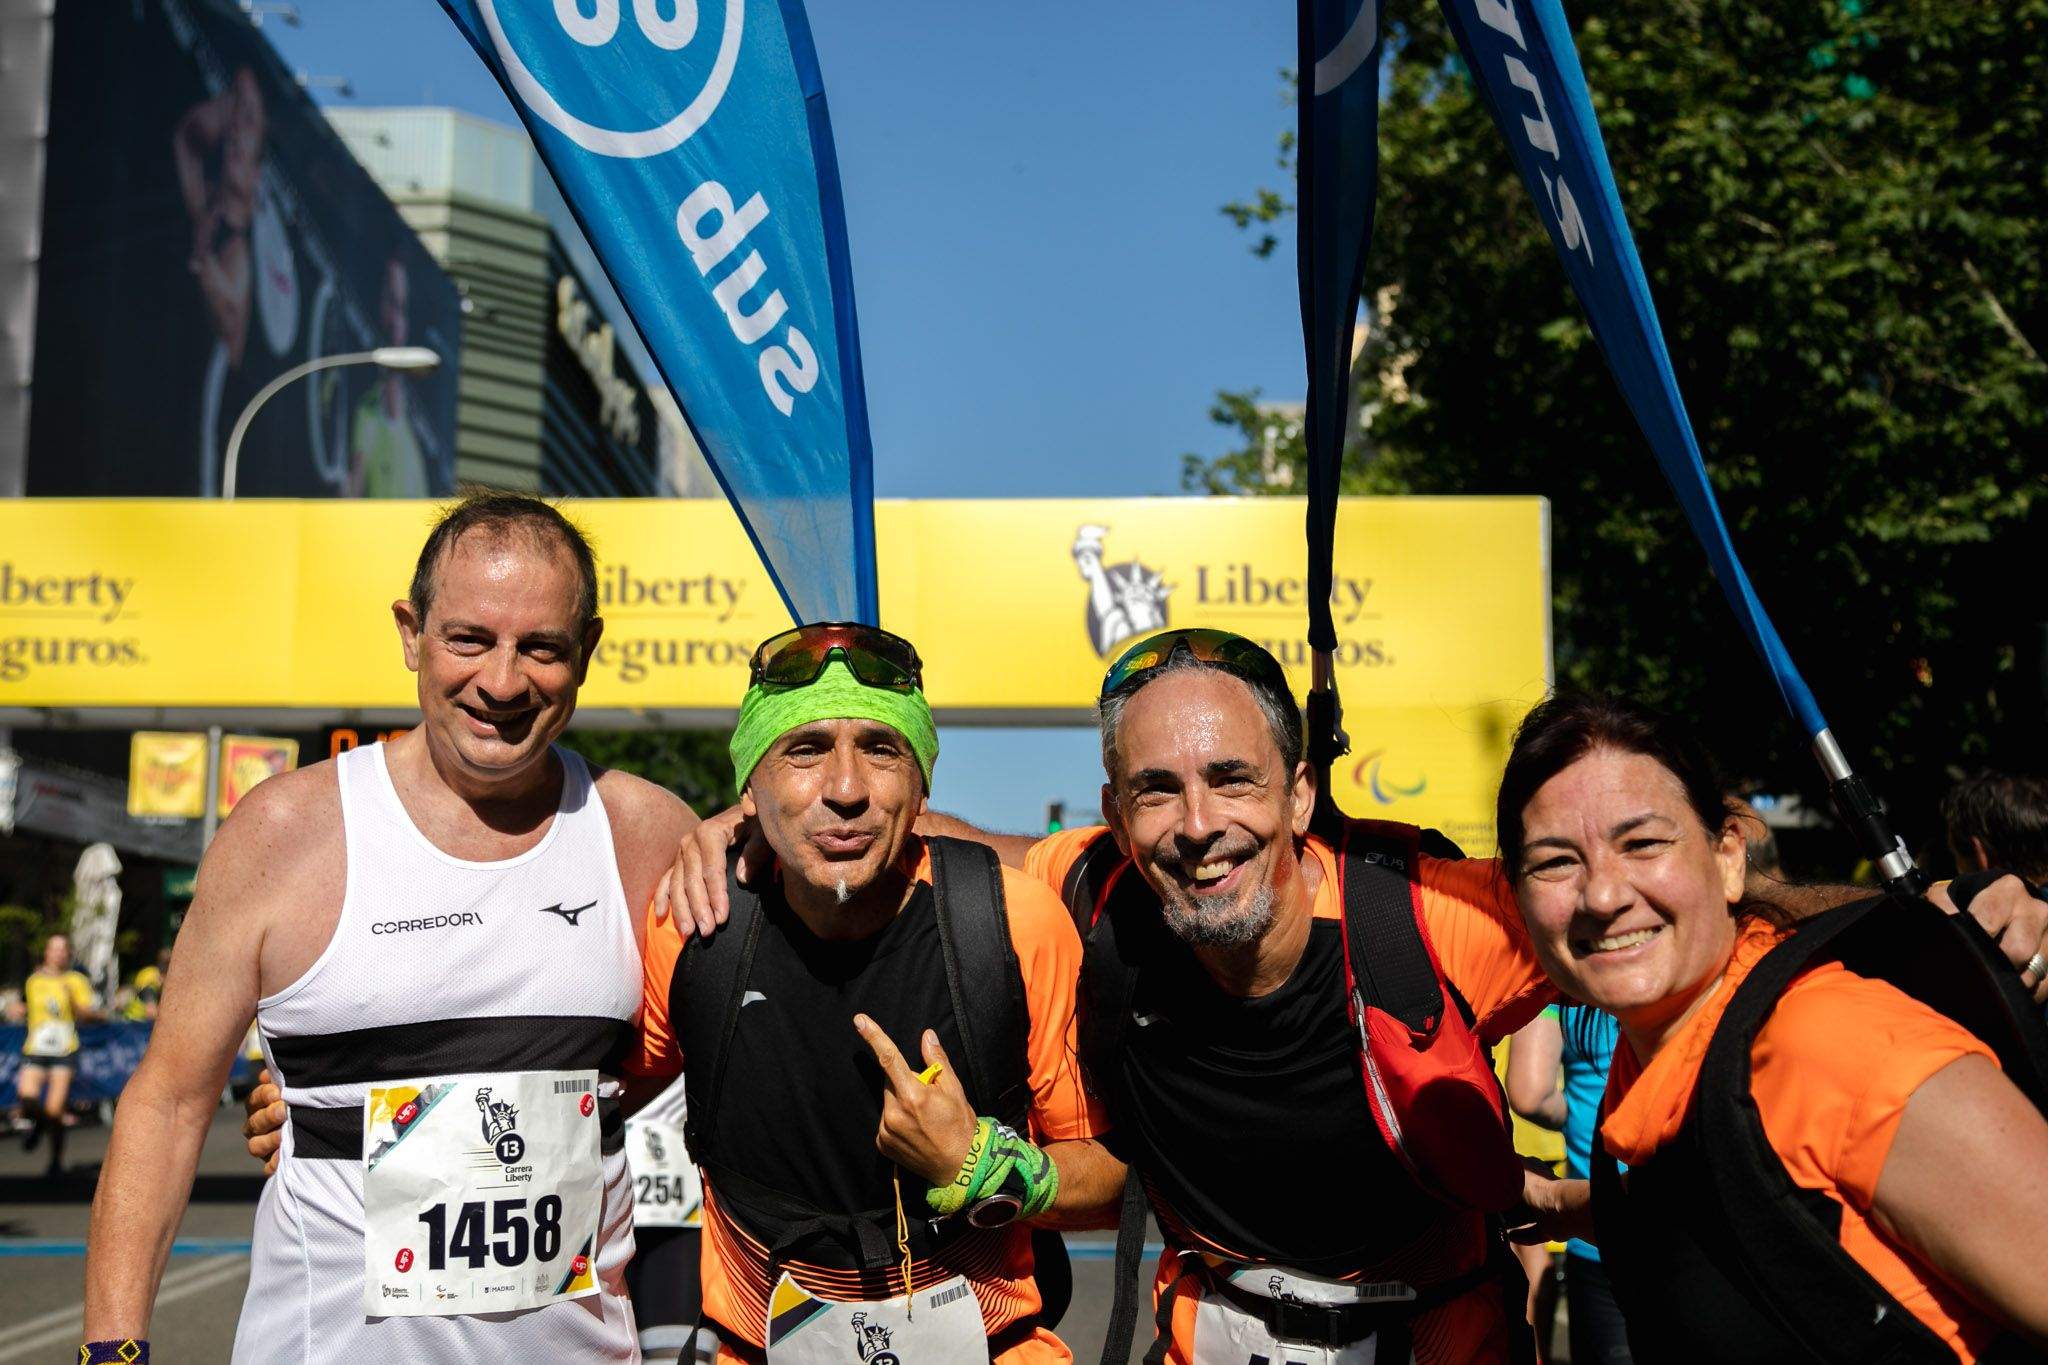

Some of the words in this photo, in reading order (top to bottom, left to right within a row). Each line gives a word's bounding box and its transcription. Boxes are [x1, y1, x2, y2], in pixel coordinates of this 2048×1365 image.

[1196, 563, 1373, 623] Libety
[501, 1140, 520, 1157] 13
[505, 1165, 533, 1174] Carrera
[505, 1173, 533, 1182] Liberty
[418, 1194, 562, 1271] 1458
